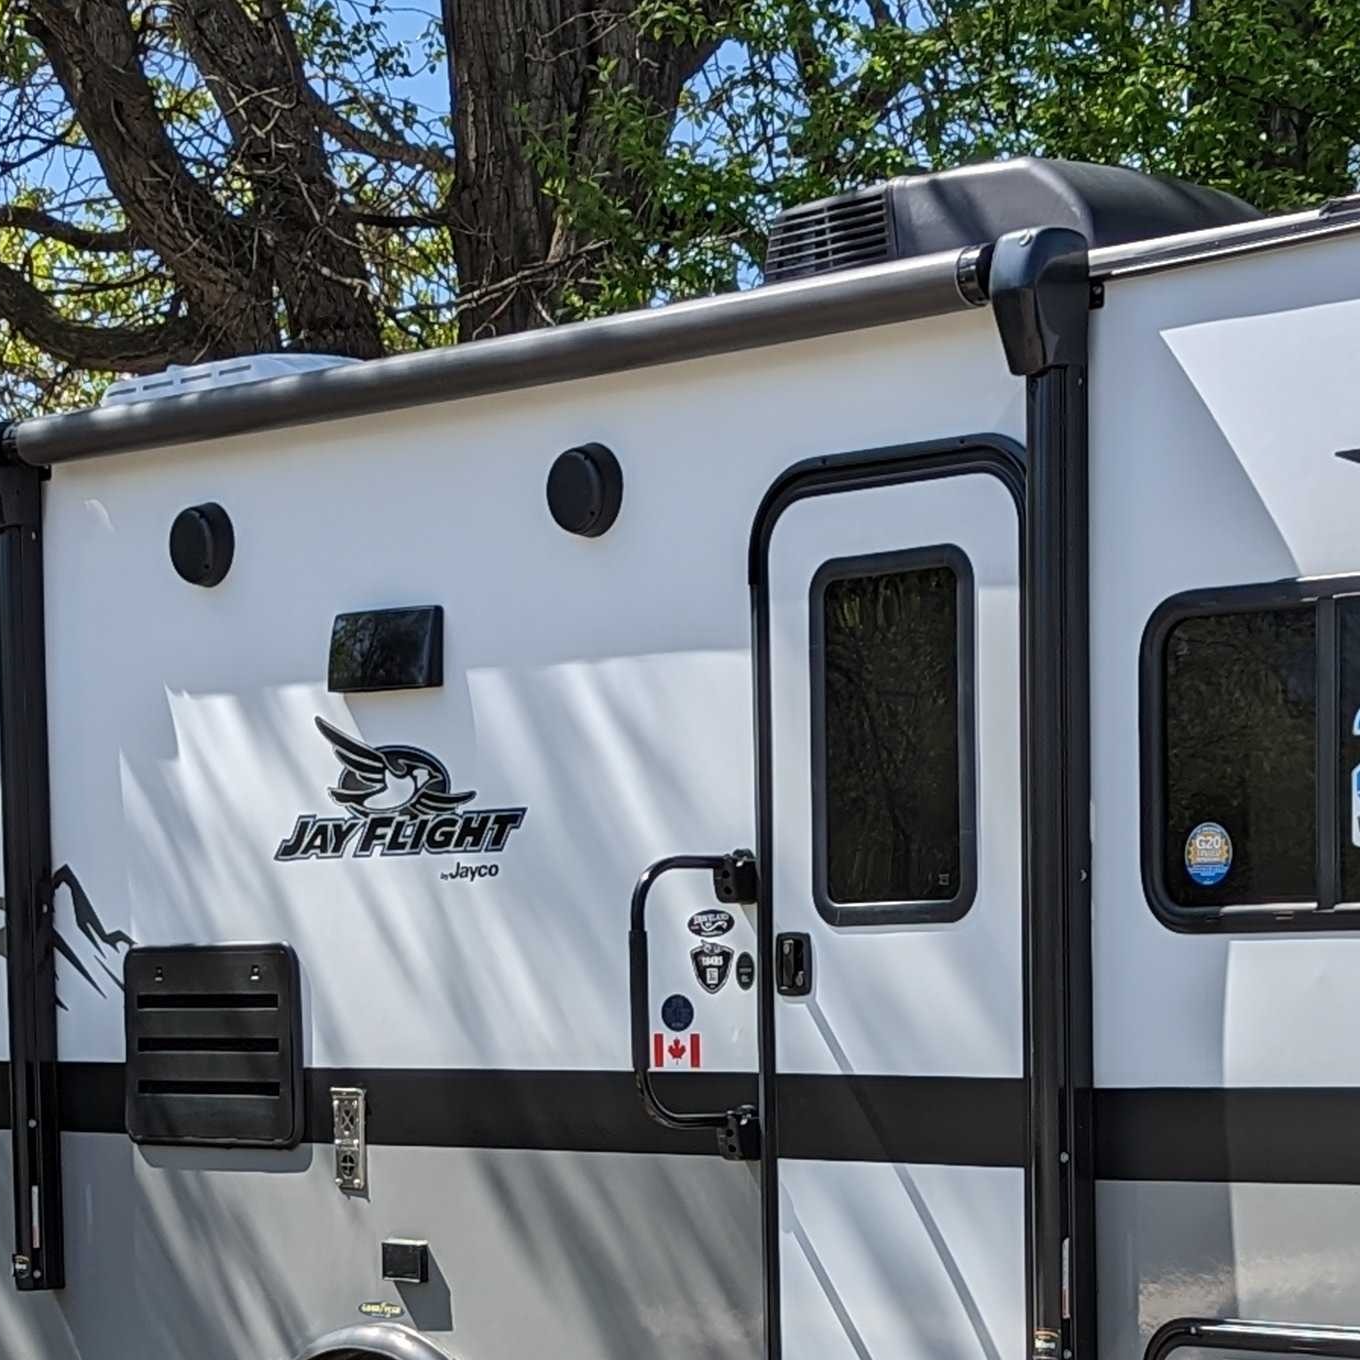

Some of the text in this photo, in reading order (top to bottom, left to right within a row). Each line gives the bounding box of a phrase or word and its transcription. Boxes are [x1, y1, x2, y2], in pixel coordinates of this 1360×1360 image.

[274, 807, 528, 860] JAY FLIGHT
[449, 861, 499, 881] Jayco
